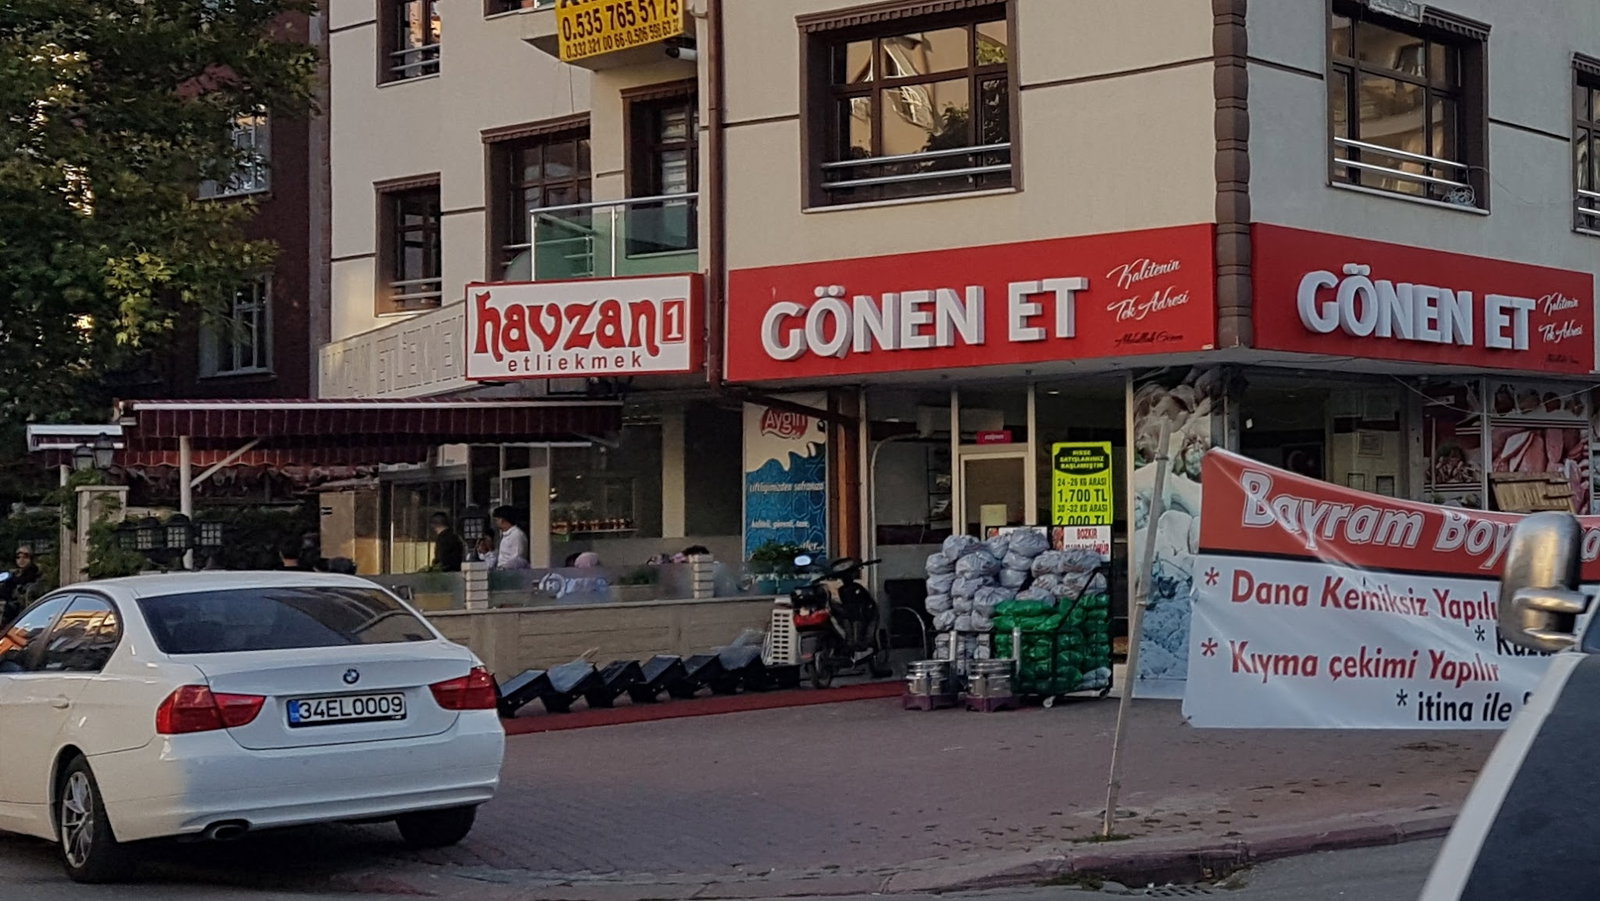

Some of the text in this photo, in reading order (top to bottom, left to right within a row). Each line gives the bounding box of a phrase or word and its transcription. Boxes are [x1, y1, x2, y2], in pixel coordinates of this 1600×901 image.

[562, 8, 603, 42] 0.535
[605, 1, 636, 31] 765
[566, 41, 588, 59] 0.332
[1106, 258, 1181, 290] Kalitenin
[761, 276, 1089, 361] GÖNEN ET
[1106, 285, 1189, 322] Tek Adresi
[1297, 263, 1536, 350] GÖNEN ET
[474, 291, 660, 362] havzan
[508, 351, 642, 372] etliekmek
[1057, 488, 1108, 503] 1.700 TL
[1240, 468, 1425, 551] Bayram
[1057, 515, 1091, 526] 2000
[1231, 569, 1498, 627] Dana Kemiksiz Yapılı
[1229, 640, 1499, 689] Kıyma çekimi Yapılır
[1418, 691, 1473, 722] itina
[1482, 692, 1513, 722] ile
